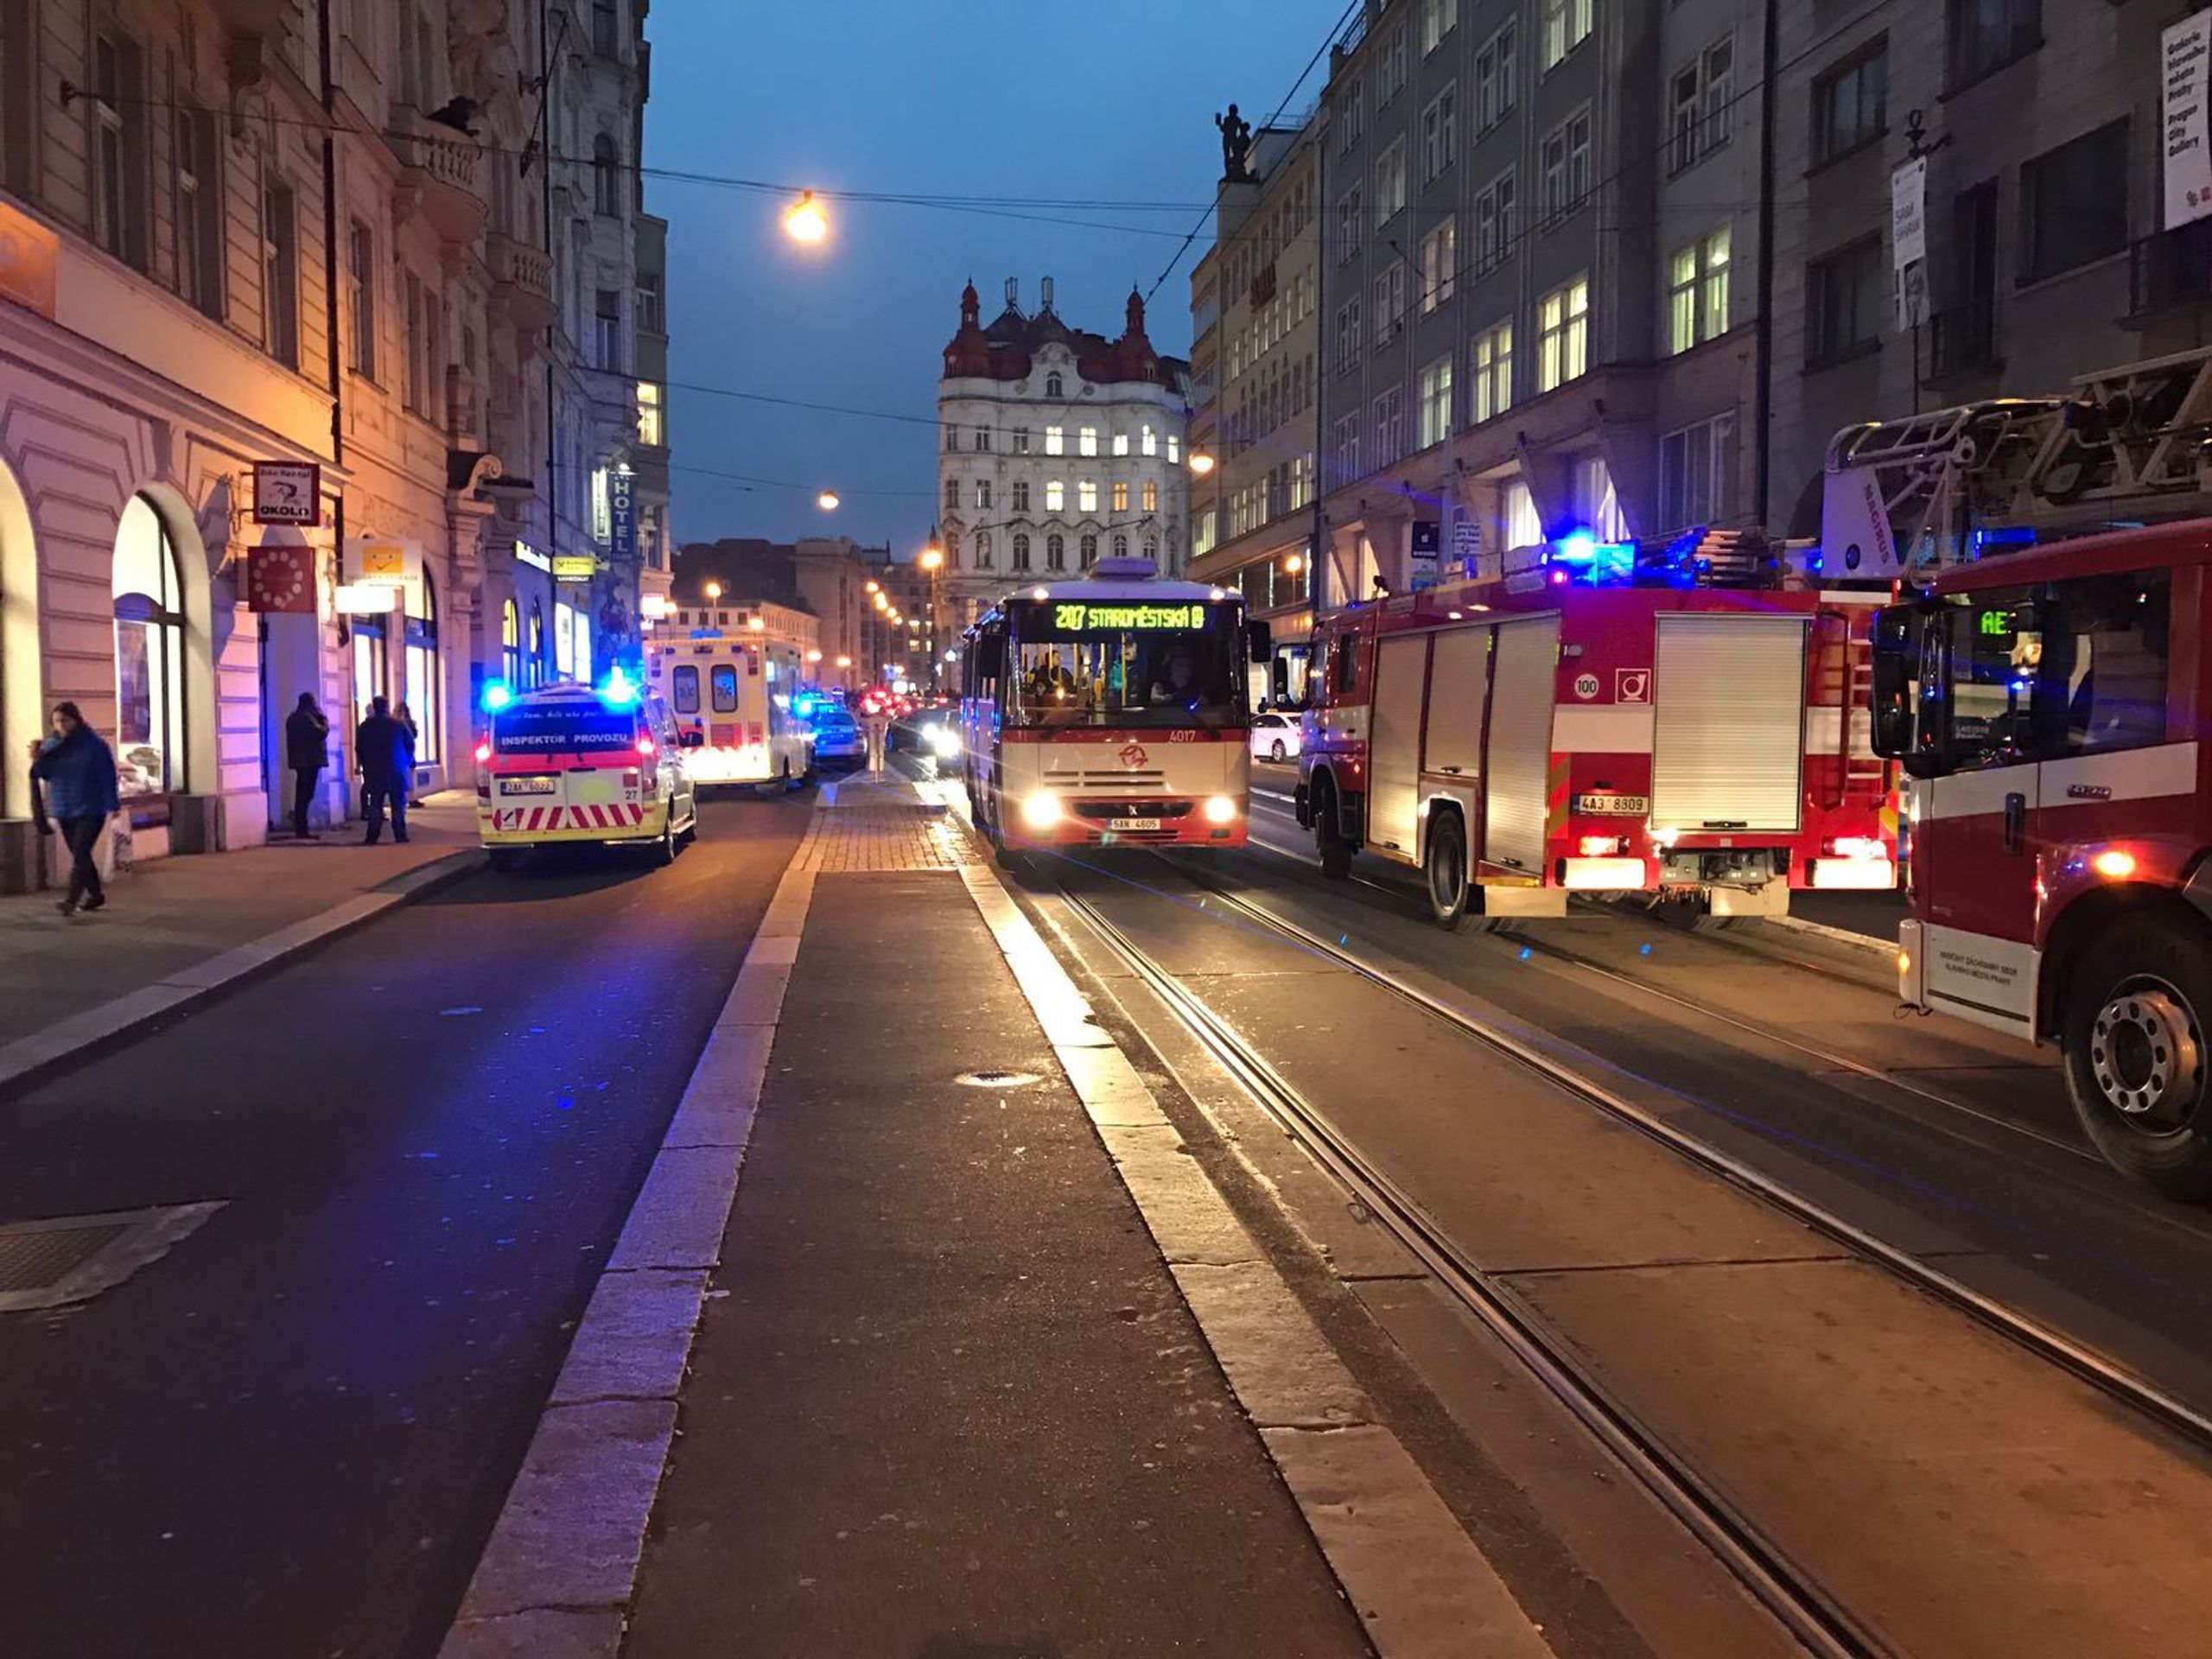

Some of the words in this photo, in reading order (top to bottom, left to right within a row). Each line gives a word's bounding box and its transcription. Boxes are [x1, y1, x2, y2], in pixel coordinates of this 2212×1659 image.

[261, 505, 309, 517] OKOLO
[614, 481, 630, 552] HOTEL
[1865, 484, 1890, 564] MAGIRUS
[1056, 605, 1086, 631] 207
[1578, 679, 1597, 693] 100
[501, 735, 566, 746] INSPEKTOR
[574, 734, 627, 743] PROVOZU
[1169, 730, 1196, 741] 4017
[626, 790, 638, 800] 27
